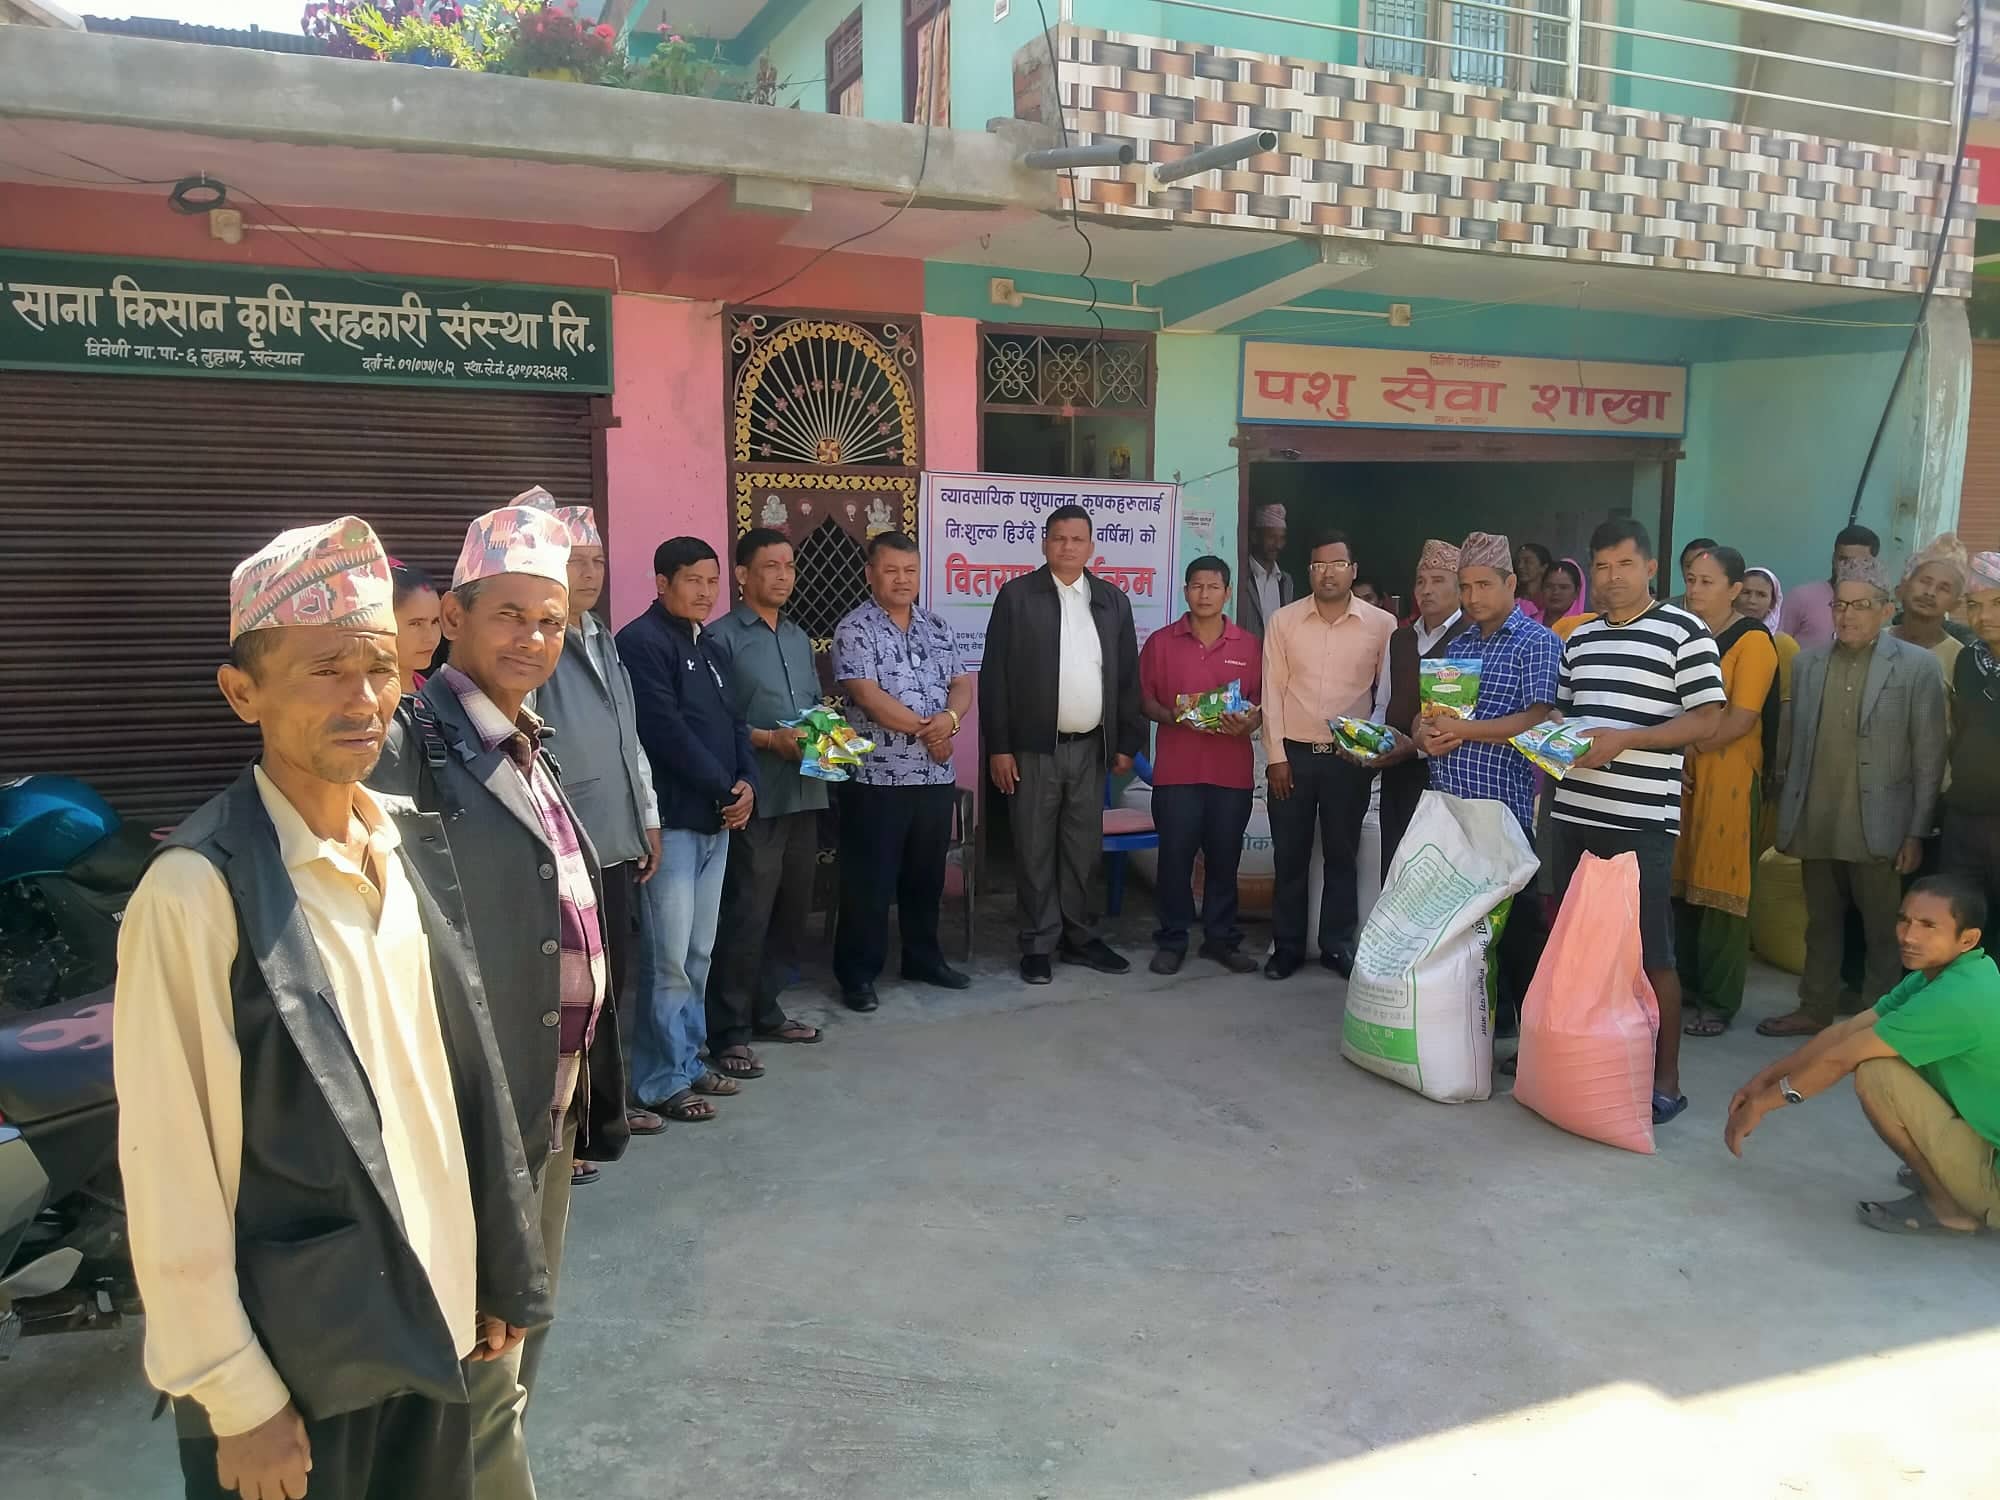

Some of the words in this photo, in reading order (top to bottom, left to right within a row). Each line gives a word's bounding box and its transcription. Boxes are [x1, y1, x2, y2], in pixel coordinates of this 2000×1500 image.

[8, 283, 104, 331] साना
[110, 275, 230, 337] किसान
[235, 283, 305, 348] कृषि
[308, 291, 431, 350] सहकारी
[437, 301, 543, 350] संस्था
[549, 300, 596, 356] लि.
[1254, 370, 1356, 420] पशु
[1381, 367, 1506, 413] सेवा
[1530, 383, 1671, 424] शाखा
[941, 485, 1016, 506] व्यावसायिक
[1003, 520, 1036, 543] हिउँदे
[1139, 525, 1156, 544] को
